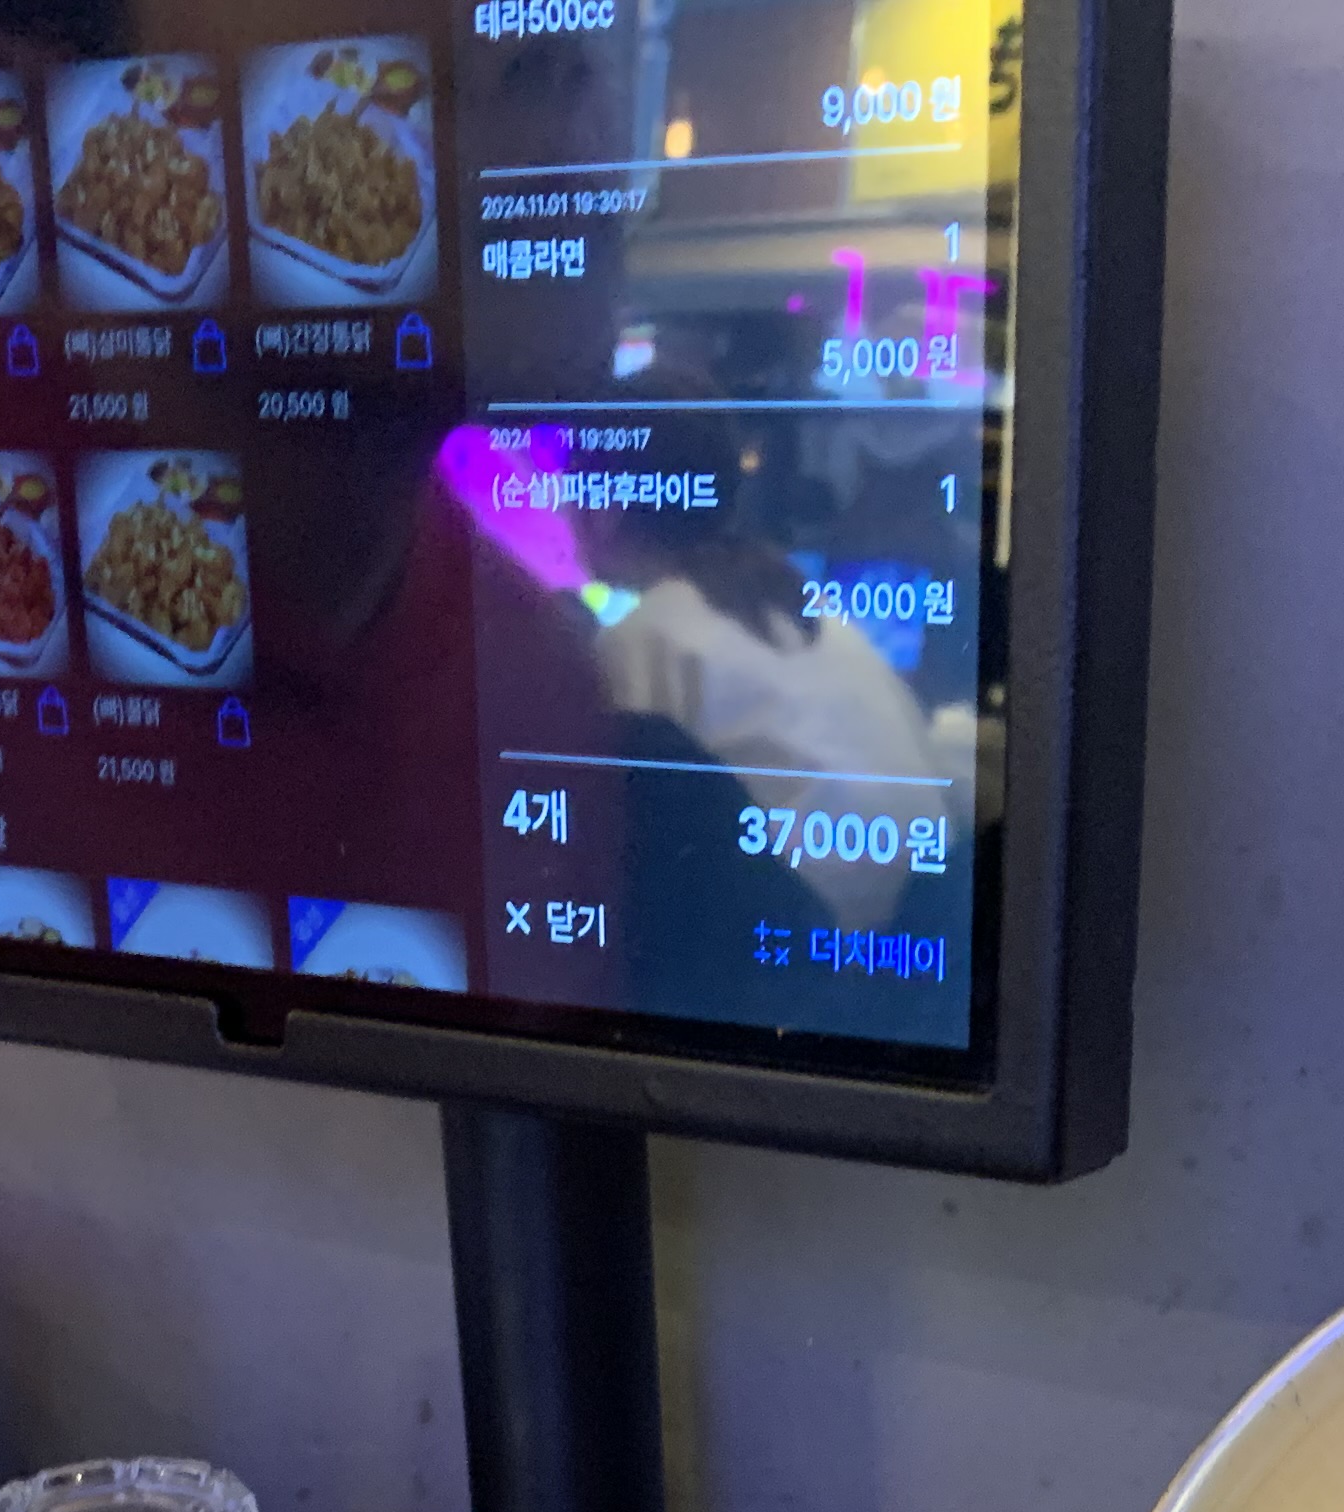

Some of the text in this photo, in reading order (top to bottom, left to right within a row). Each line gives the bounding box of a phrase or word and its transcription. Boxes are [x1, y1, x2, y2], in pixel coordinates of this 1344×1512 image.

[475, 0, 615, 41] 테라500cc
[821, 75, 962, 136] 9,000 원
[482, 237, 586, 279] 매콤라면
[944, 221, 960, 262] 1
[822, 333, 958, 385] 5,000 원
[492, 471, 719, 511] (순살)파닭후라이드
[940, 474, 956, 514] 1
[801, 579, 955, 627] 23,000 원
[503, 789, 567, 844] 4개
[738, 805, 947, 875] 37,000 원
[546, 900, 605, 948] 닫기
[810, 927, 946, 983] 더치페이
